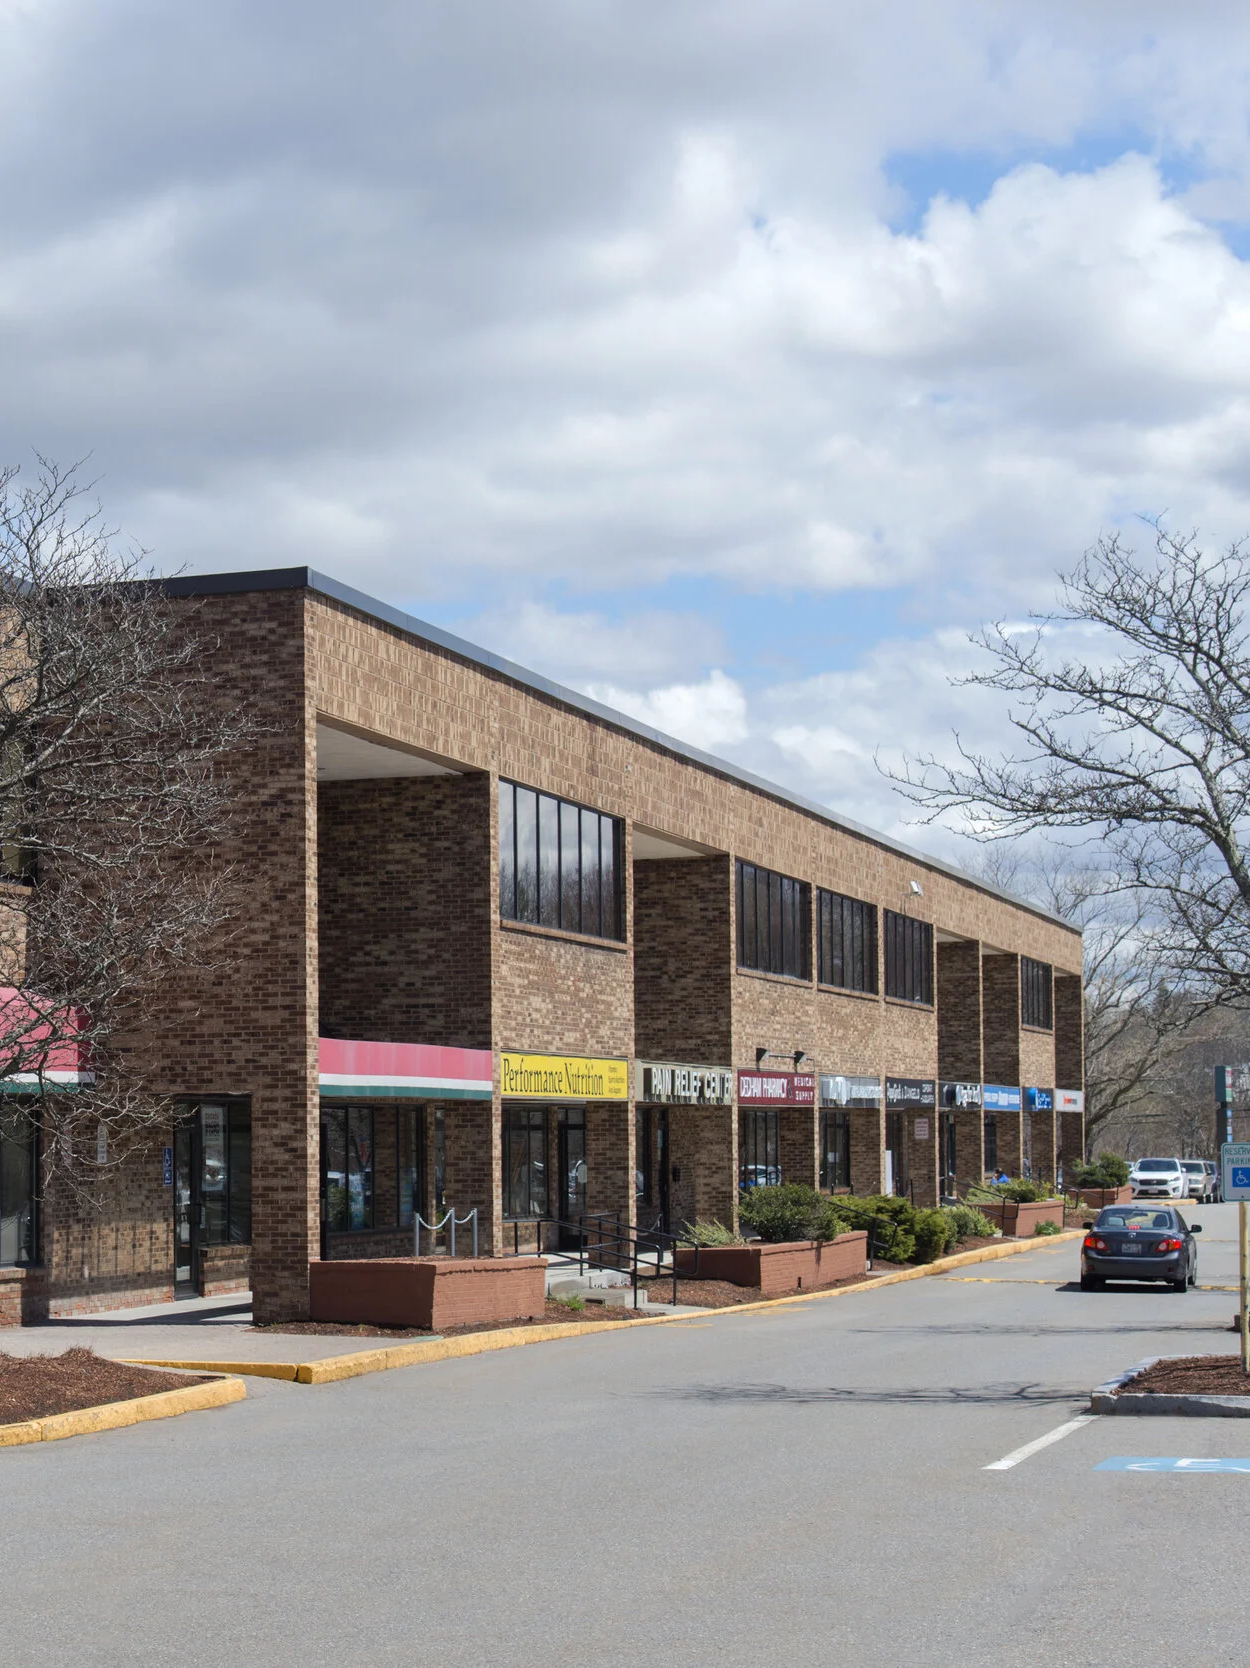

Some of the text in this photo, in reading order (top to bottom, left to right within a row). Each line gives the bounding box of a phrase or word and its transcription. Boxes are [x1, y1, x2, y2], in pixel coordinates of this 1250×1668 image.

[503, 1057, 604, 1096] Performance Nutrition
[651, 1066, 672, 1096] PAIN
[674, 1068, 703, 1098] RELIEF
[739, 1076, 788, 1099] DEDHAM PHARMACY
